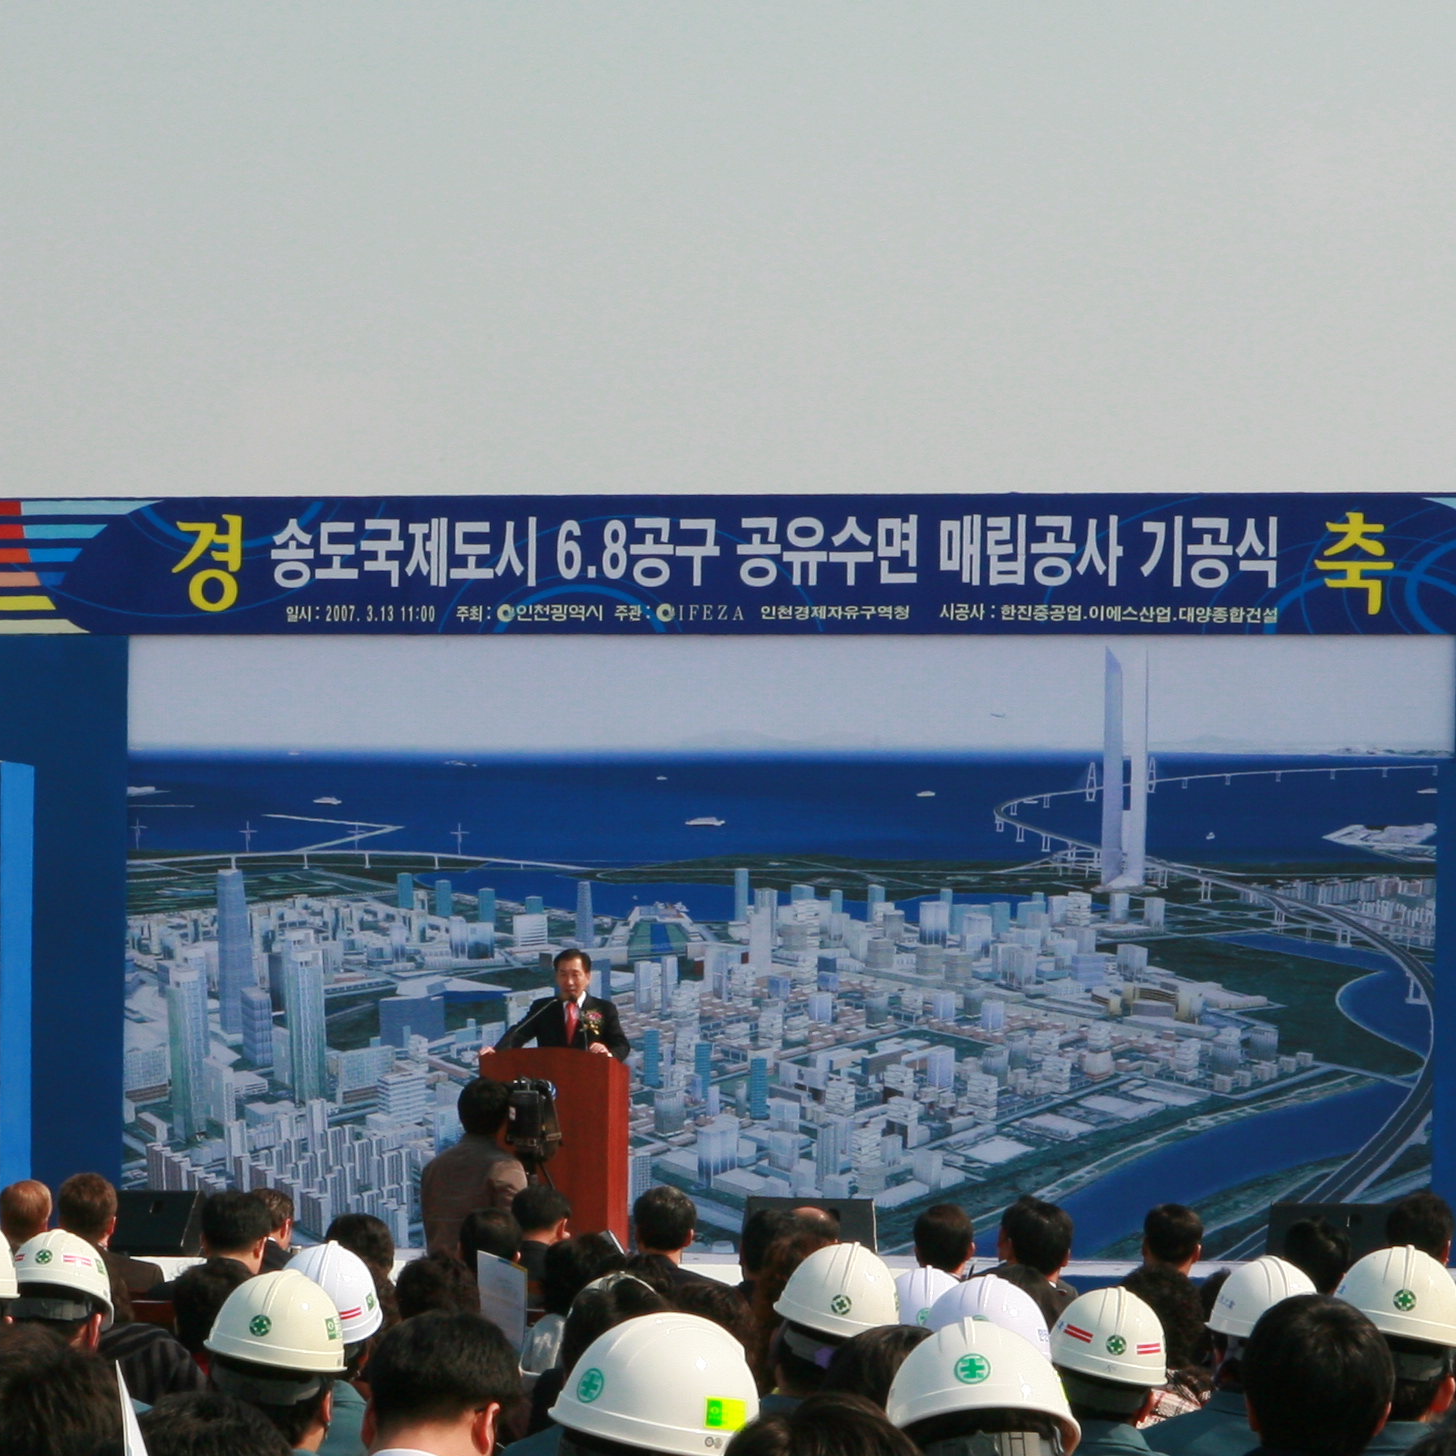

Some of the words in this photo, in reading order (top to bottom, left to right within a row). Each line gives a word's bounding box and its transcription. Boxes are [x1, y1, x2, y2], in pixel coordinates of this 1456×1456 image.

[171, 513, 243, 613] 경
[270, 516, 537, 588] 송도국제도시
[556, 516, 721, 588] 6.8공구
[736, 513, 919, 588] 공유수면
[939, 513, 1124, 587] 매립공사
[1140, 514, 1279, 588] 기공식
[1314, 511, 1395, 616] 축
[400, 605, 436, 622] 11:00
[516, 604, 603, 622] 인천광역시
[678, 604, 745, 621] IFEZA
[760, 605, 910, 620] 인천경제자유구역청
